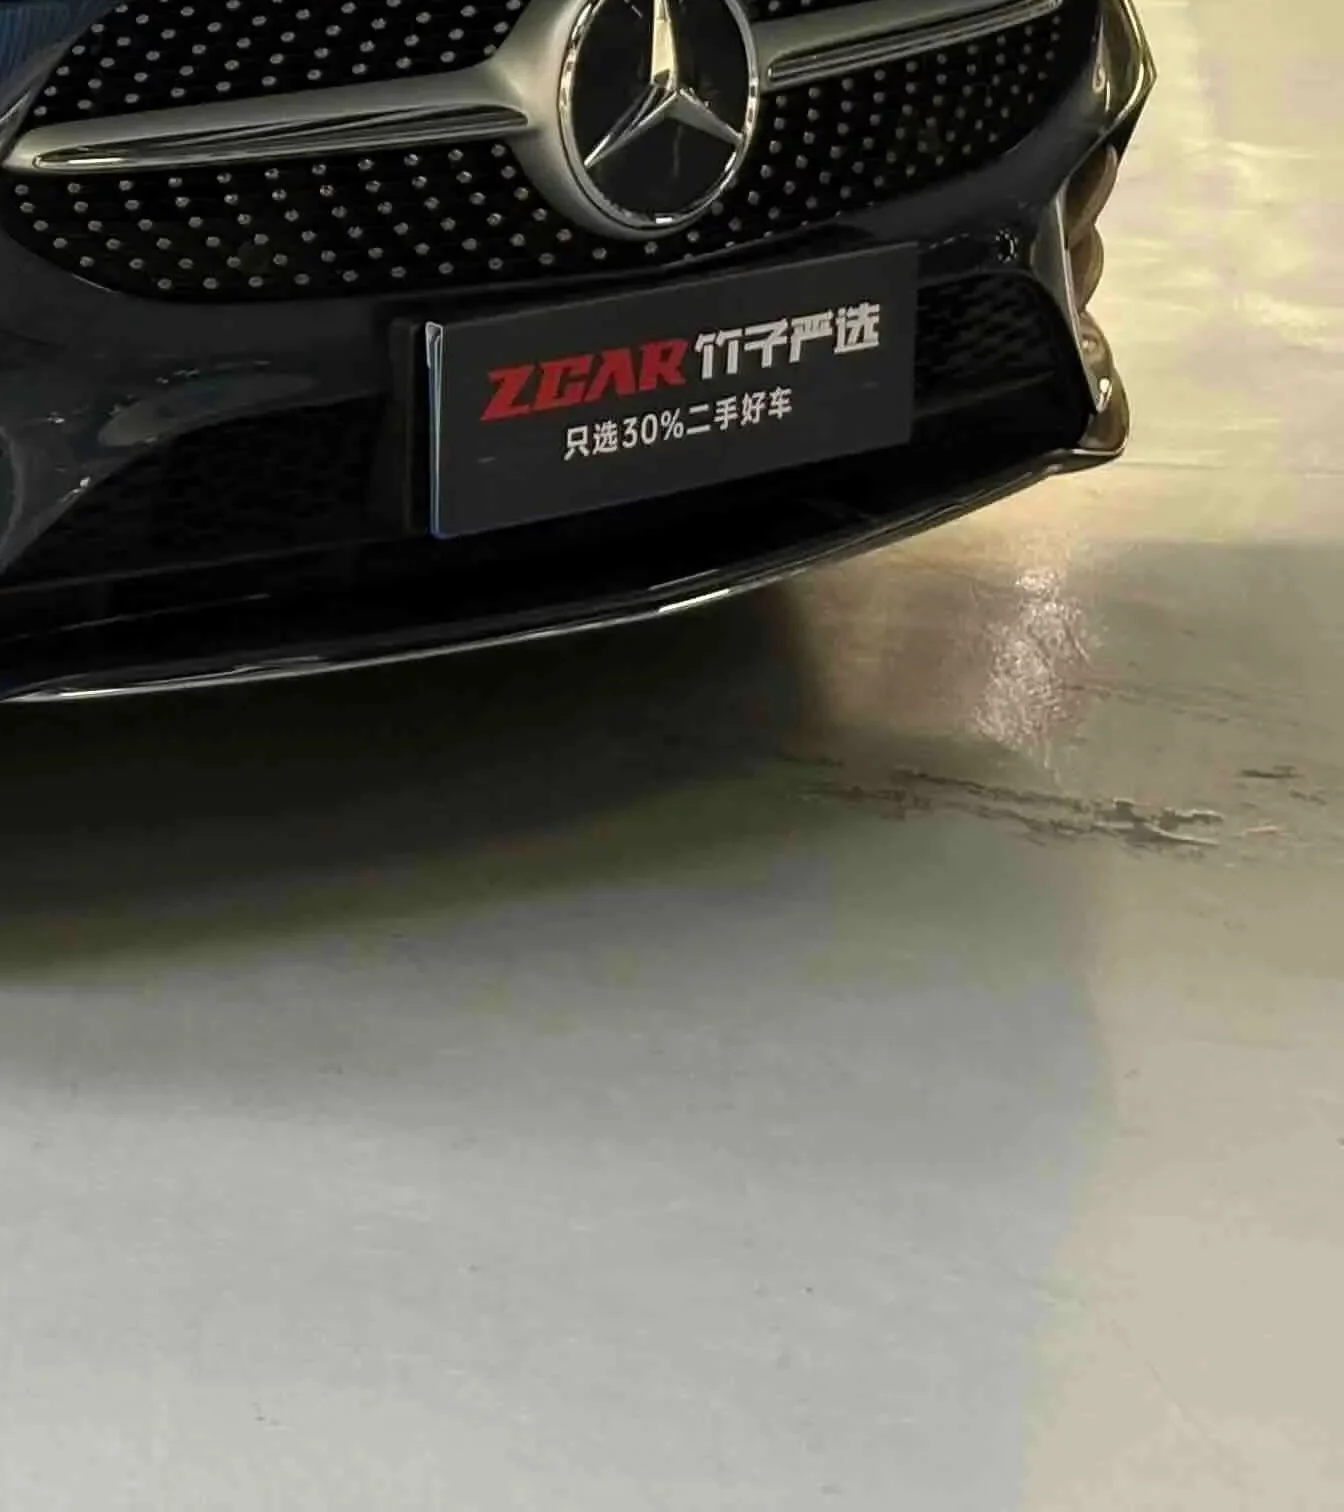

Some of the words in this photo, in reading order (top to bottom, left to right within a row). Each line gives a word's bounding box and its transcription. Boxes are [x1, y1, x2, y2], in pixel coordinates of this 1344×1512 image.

[480, 338, 692, 421] ZCAR
[695, 301, 881, 380] 竹子严选
[563, 386, 794, 461] 只选30%二手好车
